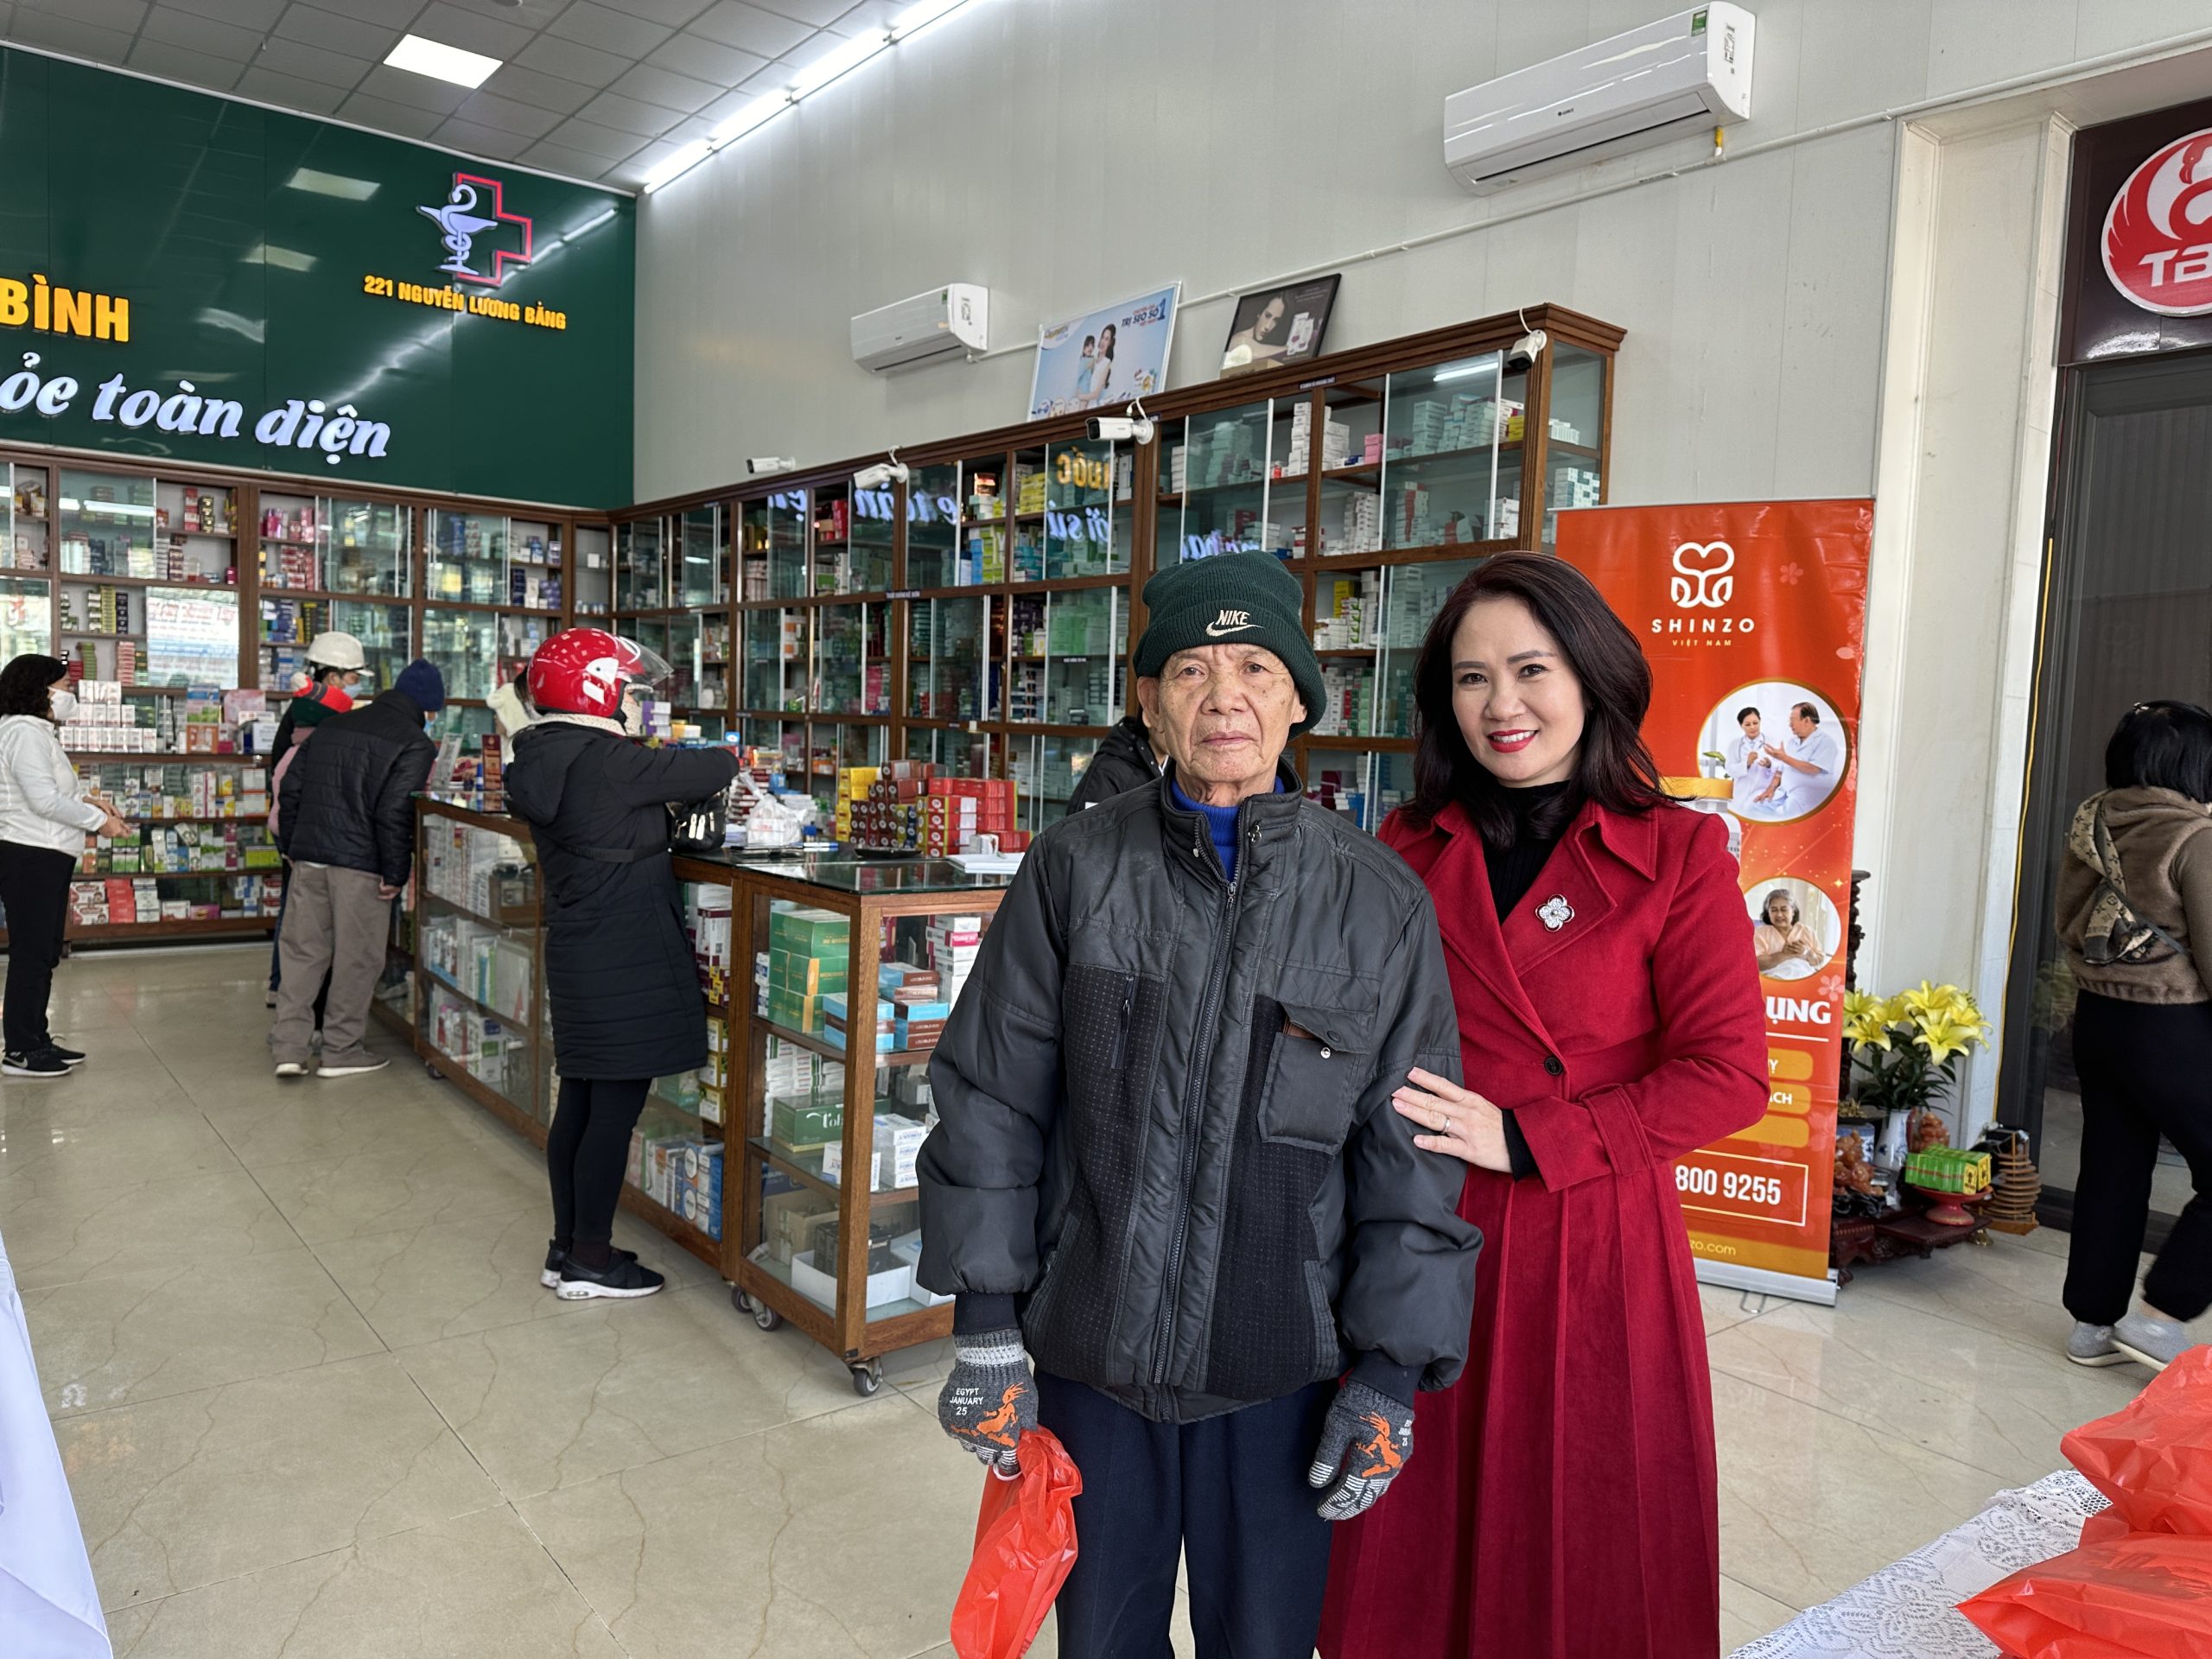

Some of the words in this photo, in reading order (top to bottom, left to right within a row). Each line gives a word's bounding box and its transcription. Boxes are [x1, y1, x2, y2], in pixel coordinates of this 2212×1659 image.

[364, 275, 393, 296] 221
[0, 274, 129, 342] BÌNH
[92, 372, 243, 438] toàn
[255, 398, 391, 464] diện
[1215, 609, 1250, 626] NIKE
[1651, 618, 1755, 633] SHINZO
[1723, 1172, 1782, 1205] 9255
[950, 1396, 984, 1405] JANUARY
[956, 1388, 979, 1396] EGYPT
[956, 1406, 968, 1415] 25
